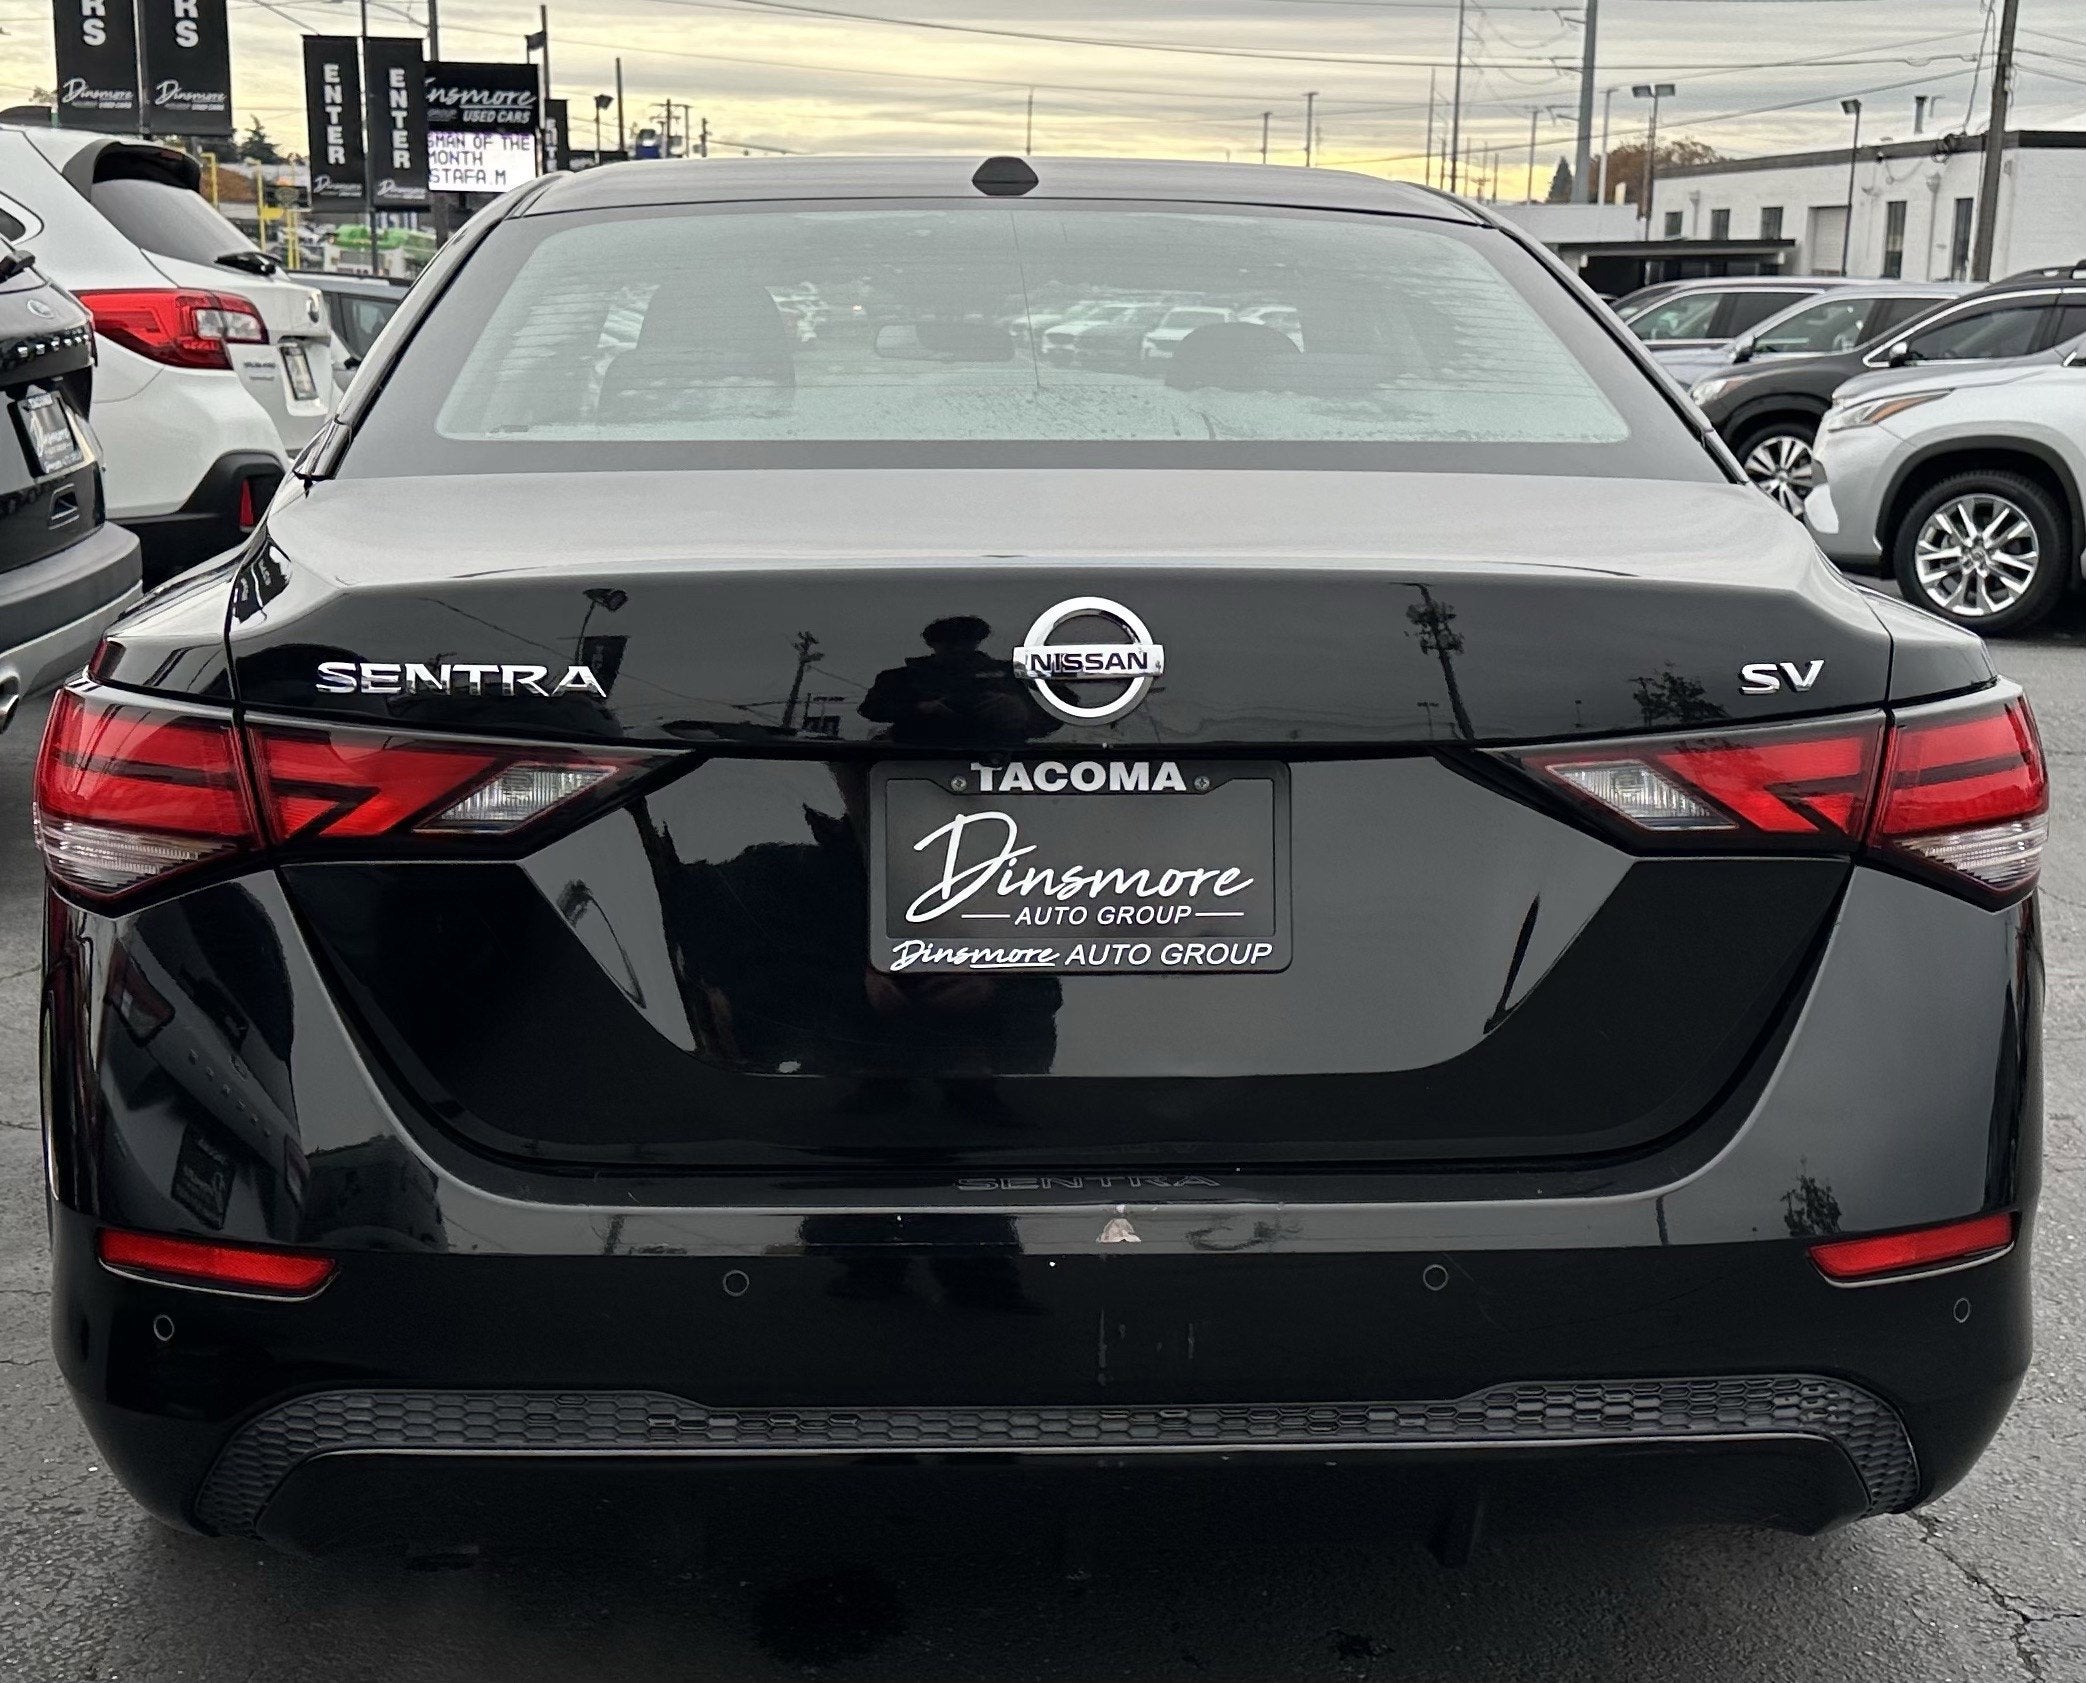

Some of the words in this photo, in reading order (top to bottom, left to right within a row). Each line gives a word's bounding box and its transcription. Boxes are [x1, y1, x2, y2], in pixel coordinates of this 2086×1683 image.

[323, 63, 346, 165] ENTER
[388, 68, 411, 169] ENTER
[462, 110, 496, 123] USED
[497, 110, 531, 124] CARS
[473, 134, 494, 149] OF
[501, 135, 530, 151] THE
[1030, 652, 1148, 671] NISSAN
[316, 662, 607, 698] SENTRA
[1741, 660, 1825, 695] SV
[969, 761, 1187, 792] TACOMA
[905, 811, 1254, 923] Dinsmore
[1014, 905, 1088, 925] AUTO
[1097, 904, 1193, 925] GROUP
[889, 939, 1060, 971] Dinsmore
[1064, 943, 1152, 966] AUTO
[1160, 942, 1273, 966] GROUP
[958, 1175, 1221, 1191] SENTRA
